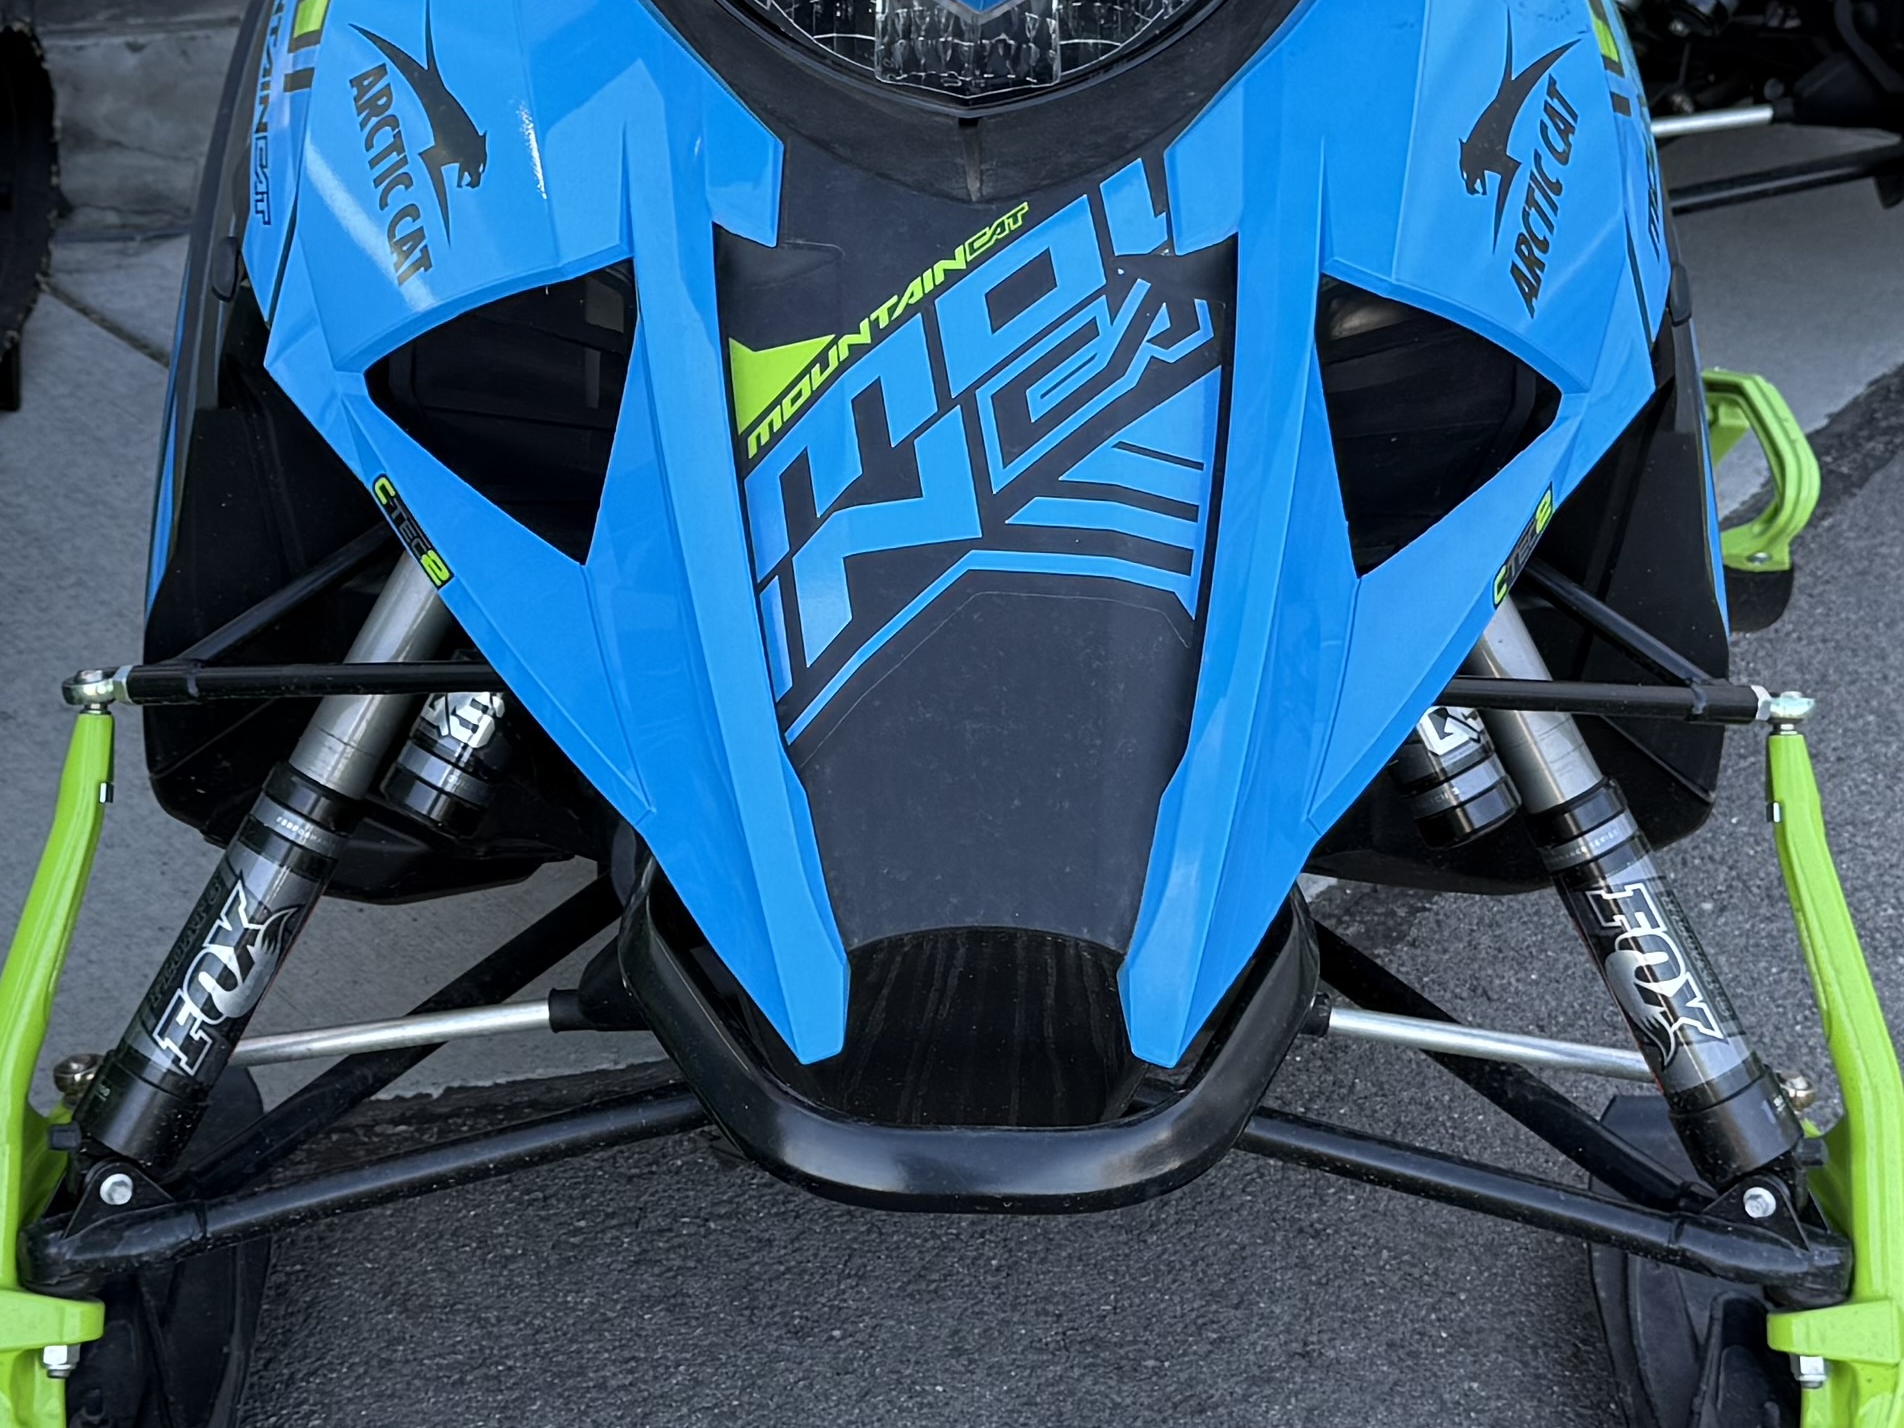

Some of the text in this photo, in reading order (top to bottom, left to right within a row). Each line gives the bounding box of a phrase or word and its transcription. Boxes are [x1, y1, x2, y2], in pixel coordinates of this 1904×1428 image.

[349, 62, 435, 287] ARCTIC CAT
[1509, 73, 1579, 320] ARCTIC CAT
[152, 879, 266, 1077] FOX
[1586, 882, 1730, 1045] FOX
